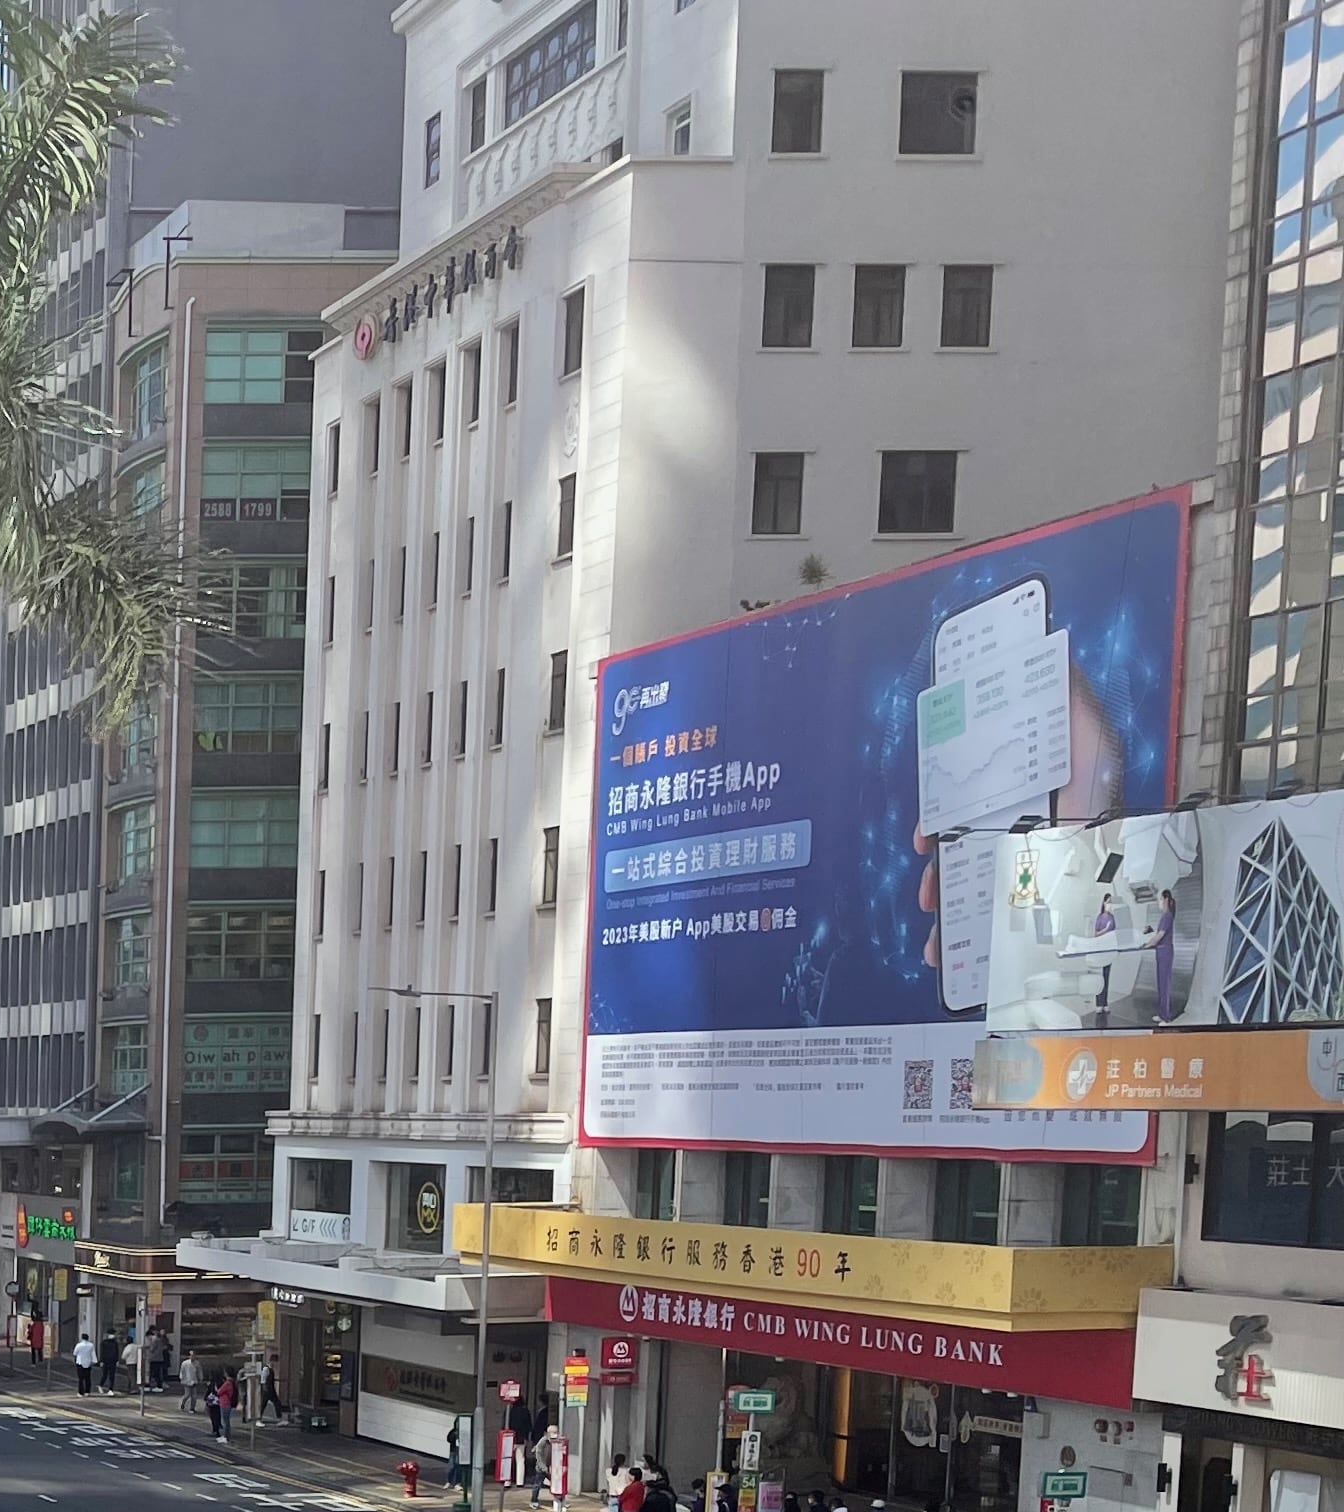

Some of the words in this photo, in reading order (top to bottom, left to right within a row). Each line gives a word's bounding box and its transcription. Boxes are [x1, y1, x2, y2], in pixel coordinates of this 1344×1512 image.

[608, 760, 782, 816] 招商永隆銀行手機App
[606, 821, 627, 836] CMB
[630, 817, 653, 832] Wing
[656, 811, 680, 827] Lung
[683, 808, 708, 823] Bank
[712, 801, 747, 817] Mobile
[750, 796, 772, 811] App
[611, 832, 797, 882] 一站式綜合投資理財服務
[1105, 1084, 1119, 1099] JP
[1121, 1083, 1161, 1099] Partners
[1163, 1083, 1204, 1099] Medical
[641, 1291, 736, 1332] 招商永隆銀行
[744, 1314, 786, 1336] CMB
[794, 1317, 851, 1345] WING
[861, 1326, 924, 1355] LUNG
[934, 1335, 1005, 1367] BANK
[741, 1476, 756, 1489] 54
